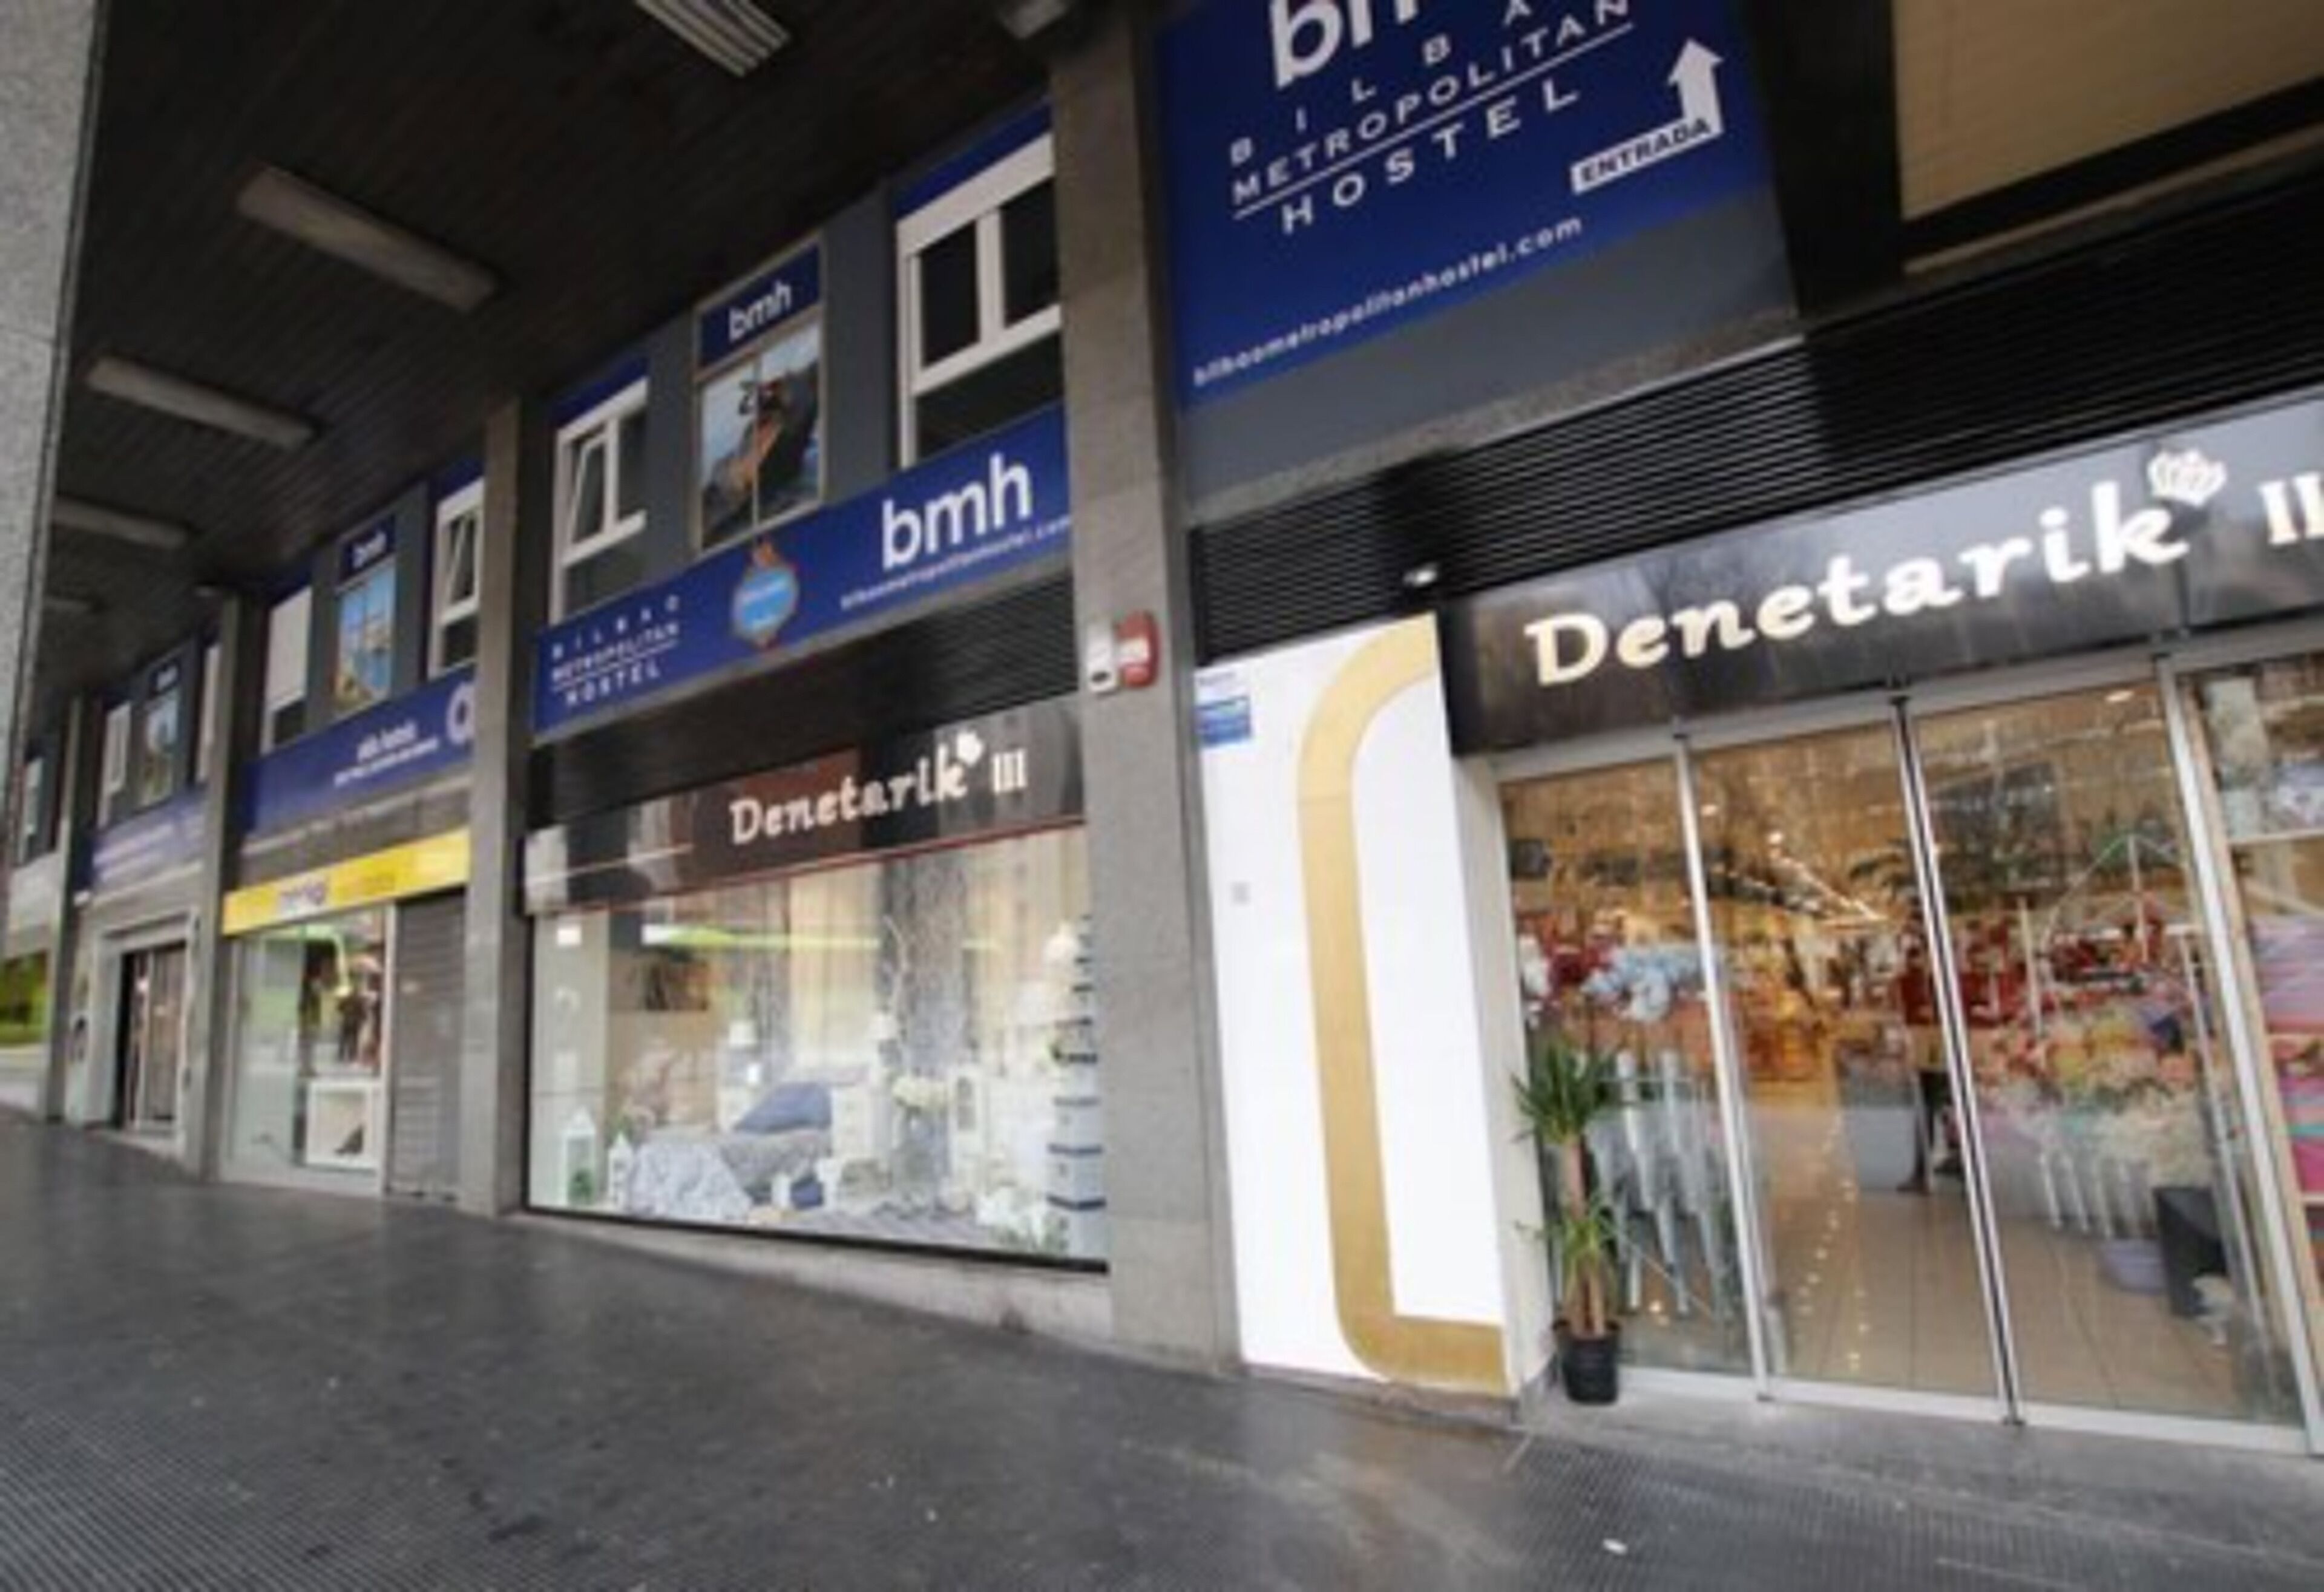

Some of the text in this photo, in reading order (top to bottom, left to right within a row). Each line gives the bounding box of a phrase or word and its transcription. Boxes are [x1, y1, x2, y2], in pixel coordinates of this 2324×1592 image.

[1232, 0, 1629, 206] METROPOLITAN
[1282, 80, 1579, 234] HOSTEL
[1580, 117, 1710, 183] ENTRADA
[729, 280, 792, 342] bmh
[882, 451, 1032, 571] bmh
[1525, 480, 2190, 686] Denetarik
[729, 742, 1027, 845] Denetarik III
